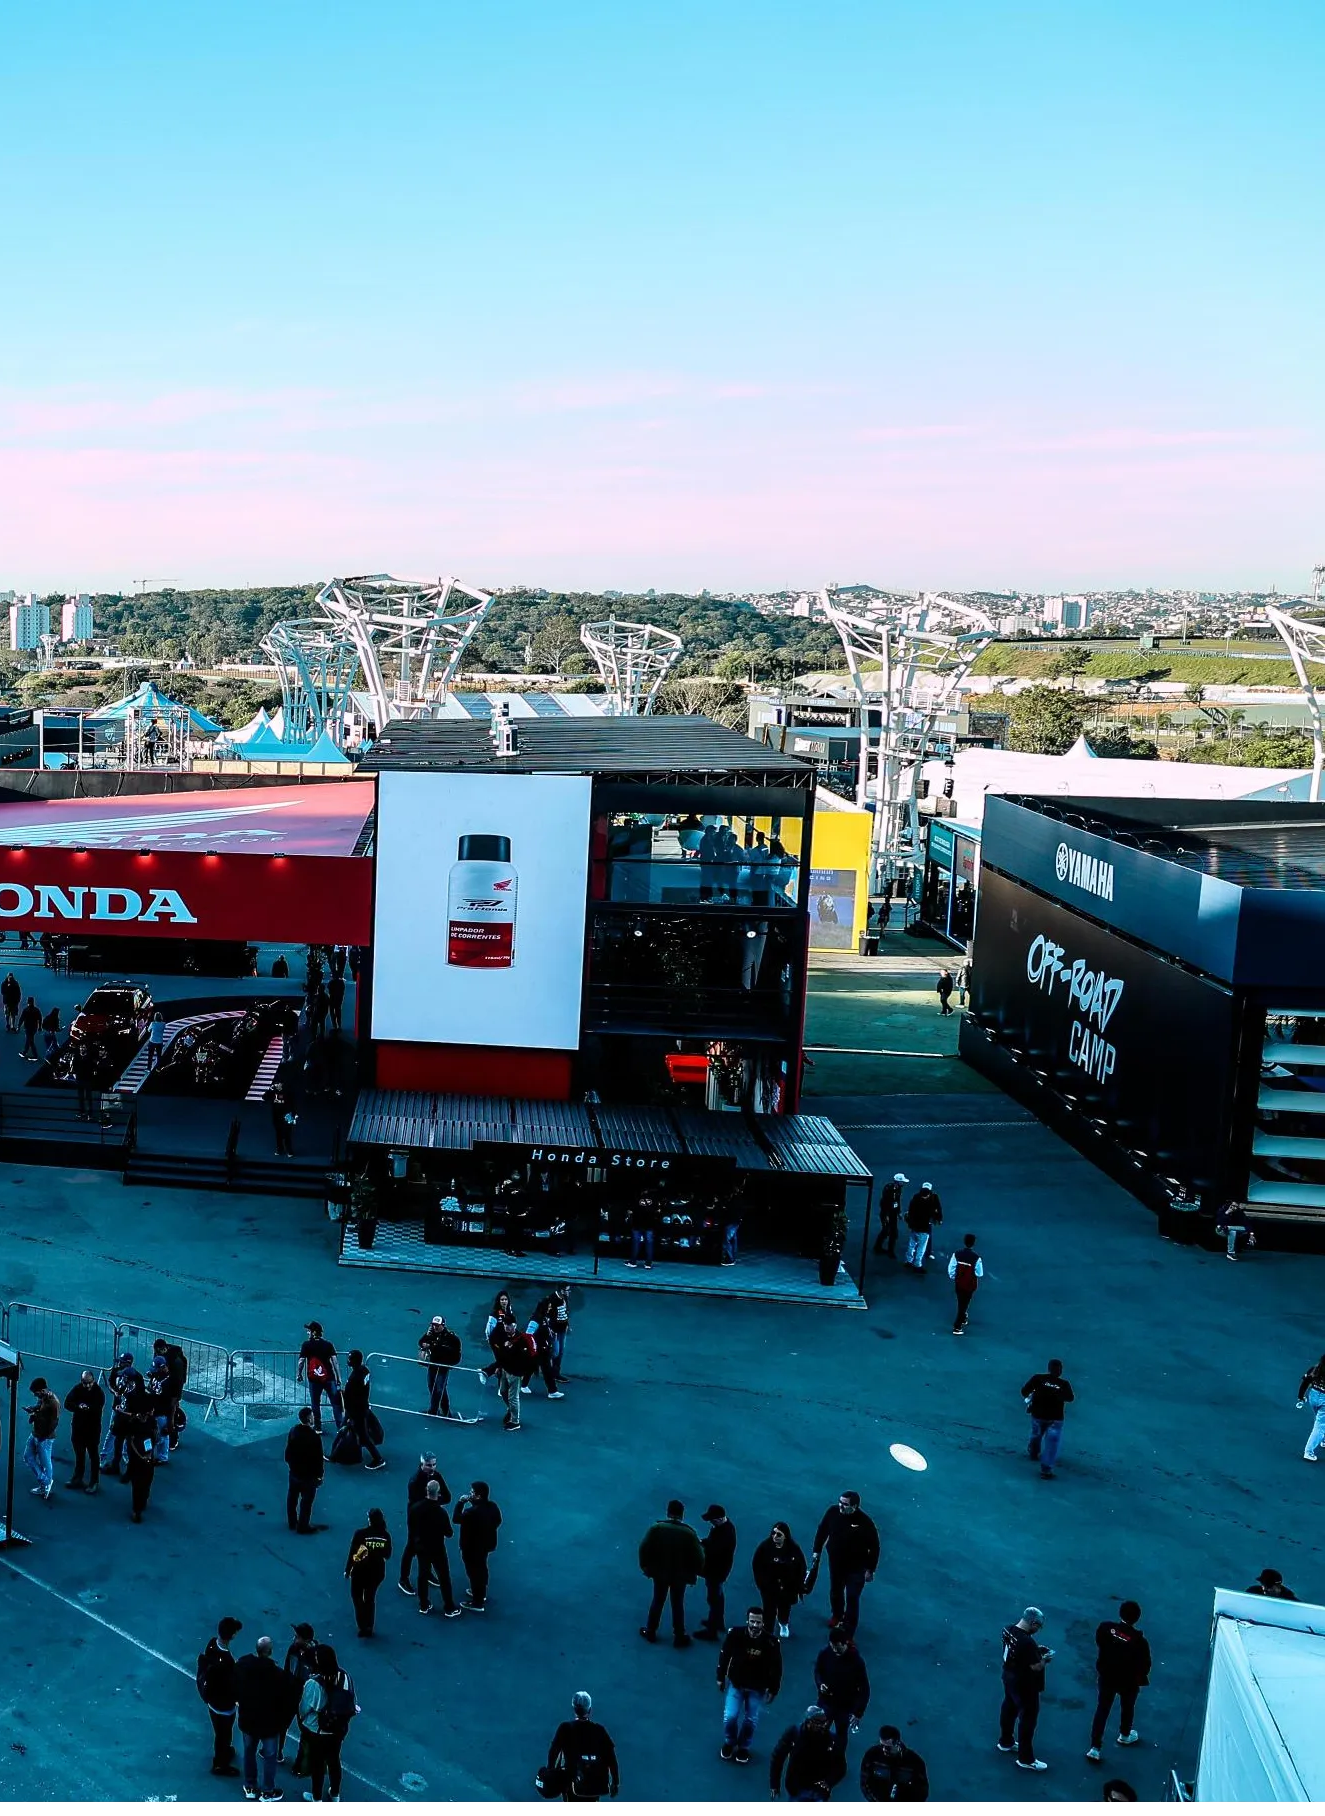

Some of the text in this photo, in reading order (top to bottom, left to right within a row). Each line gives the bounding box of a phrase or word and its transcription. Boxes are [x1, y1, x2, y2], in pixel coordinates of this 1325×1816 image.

[1069, 848, 1114, 902] YAMAHA
[451, 926, 485, 934] LIMPADOR
[1027, 934, 1124, 1033] OFF-ROAD
[1069, 1021, 1116, 1085] CAMP
[531, 1149, 670, 1169] Honda Store
